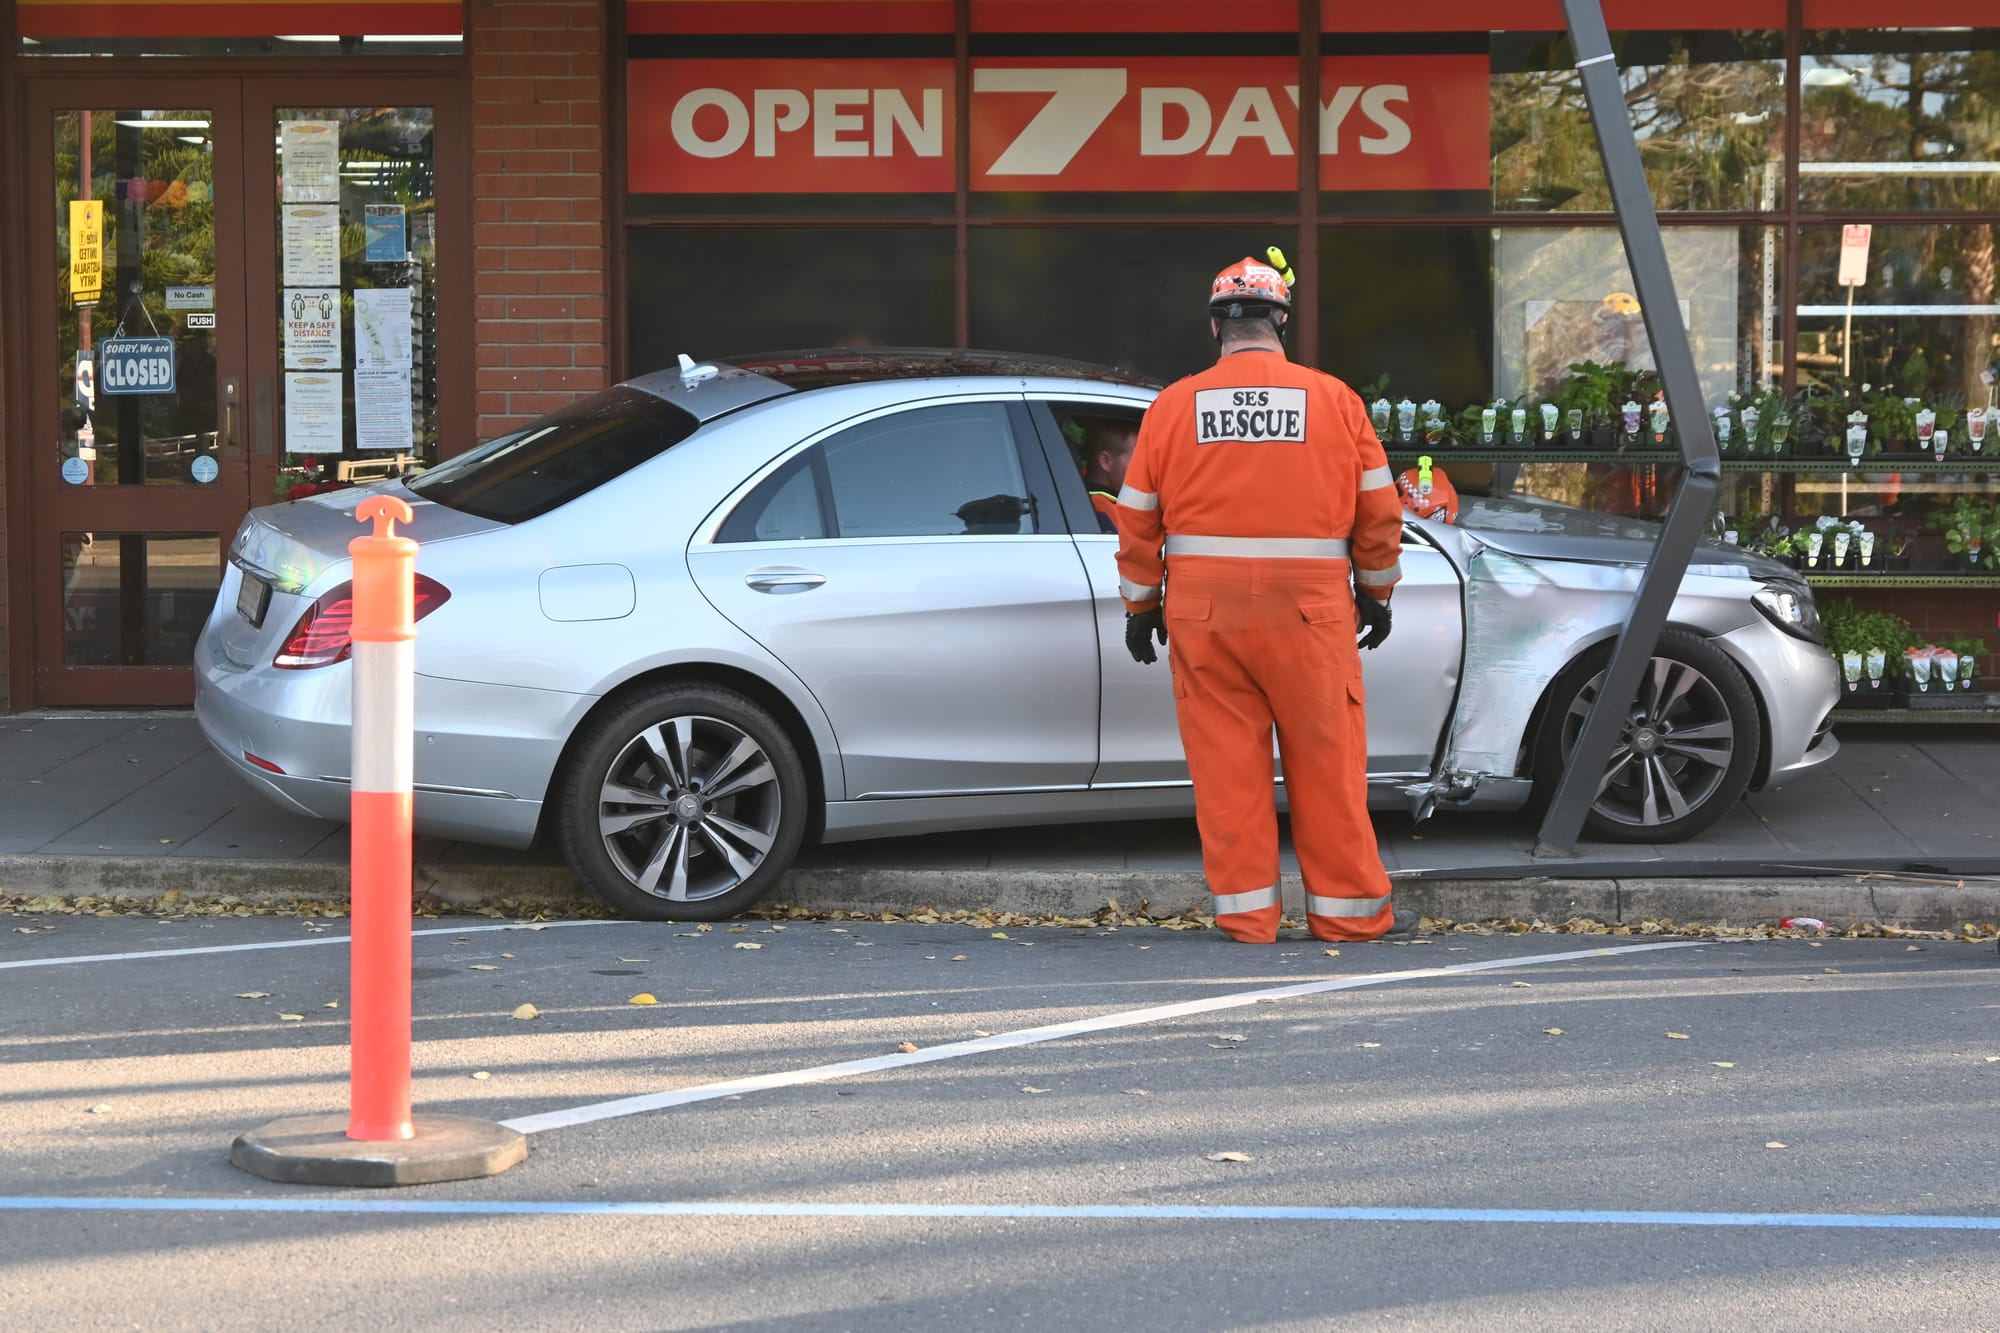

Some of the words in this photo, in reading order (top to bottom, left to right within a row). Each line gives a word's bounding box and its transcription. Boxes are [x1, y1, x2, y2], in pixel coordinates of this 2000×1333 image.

[671, 88, 943, 158] OPEN
[974, 68, 1127, 175] 7
[1141, 84, 1412, 155] DAYS
[186, 291, 205, 299] Cash
[190, 316, 212, 326] PUSH
[106, 344, 139, 354] SORRY,
[140, 344, 152, 353] We
[155, 345, 169, 353] are
[105, 358, 170, 387] CLOSED
[1232, 391, 1269, 406] SES
[1201, 409, 1300, 438] RESCUE
